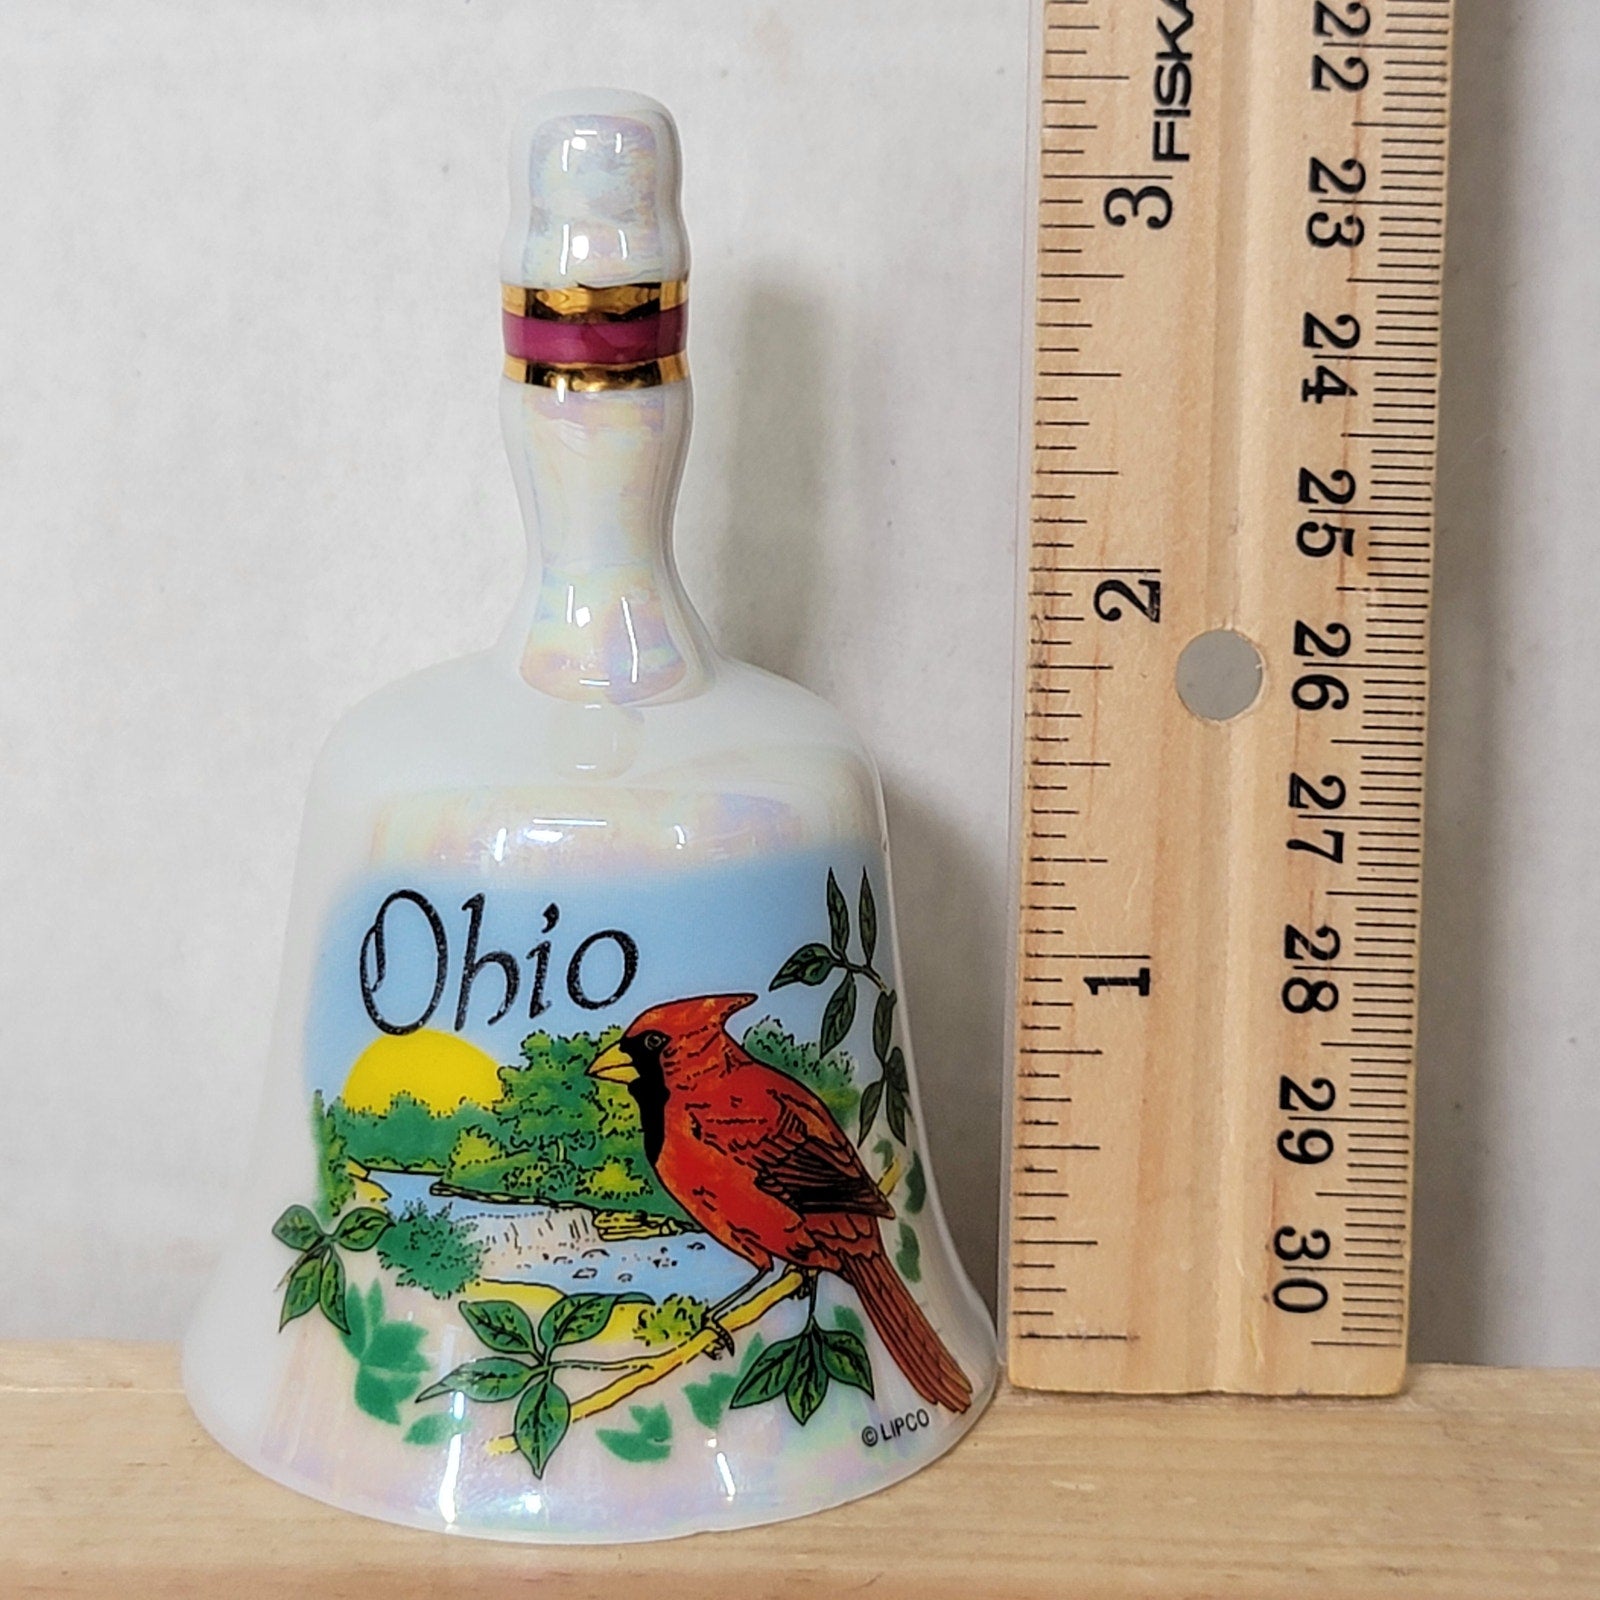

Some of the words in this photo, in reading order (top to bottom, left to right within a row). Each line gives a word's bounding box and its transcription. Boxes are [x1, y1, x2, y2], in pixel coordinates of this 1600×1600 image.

[1312, 0, 1371, 92] 22
[1103, 185, 1173, 230] 3
[1306, 156, 1367, 249] 23
[1301, 311, 1361, 405] 24
[1296, 467, 1357, 558] 25
[1093, 579, 1161, 624] 2
[1291, 619, 1352, 711] 26
[1286, 772, 1347, 864] 27
[359, 888, 640, 1036] Ohio
[1083, 967, 1151, 997] 1
[1281, 924, 1341, 1014] 28
[1276, 1074, 1336, 1165] 29
[1271, 1225, 1331, 1314] 30
